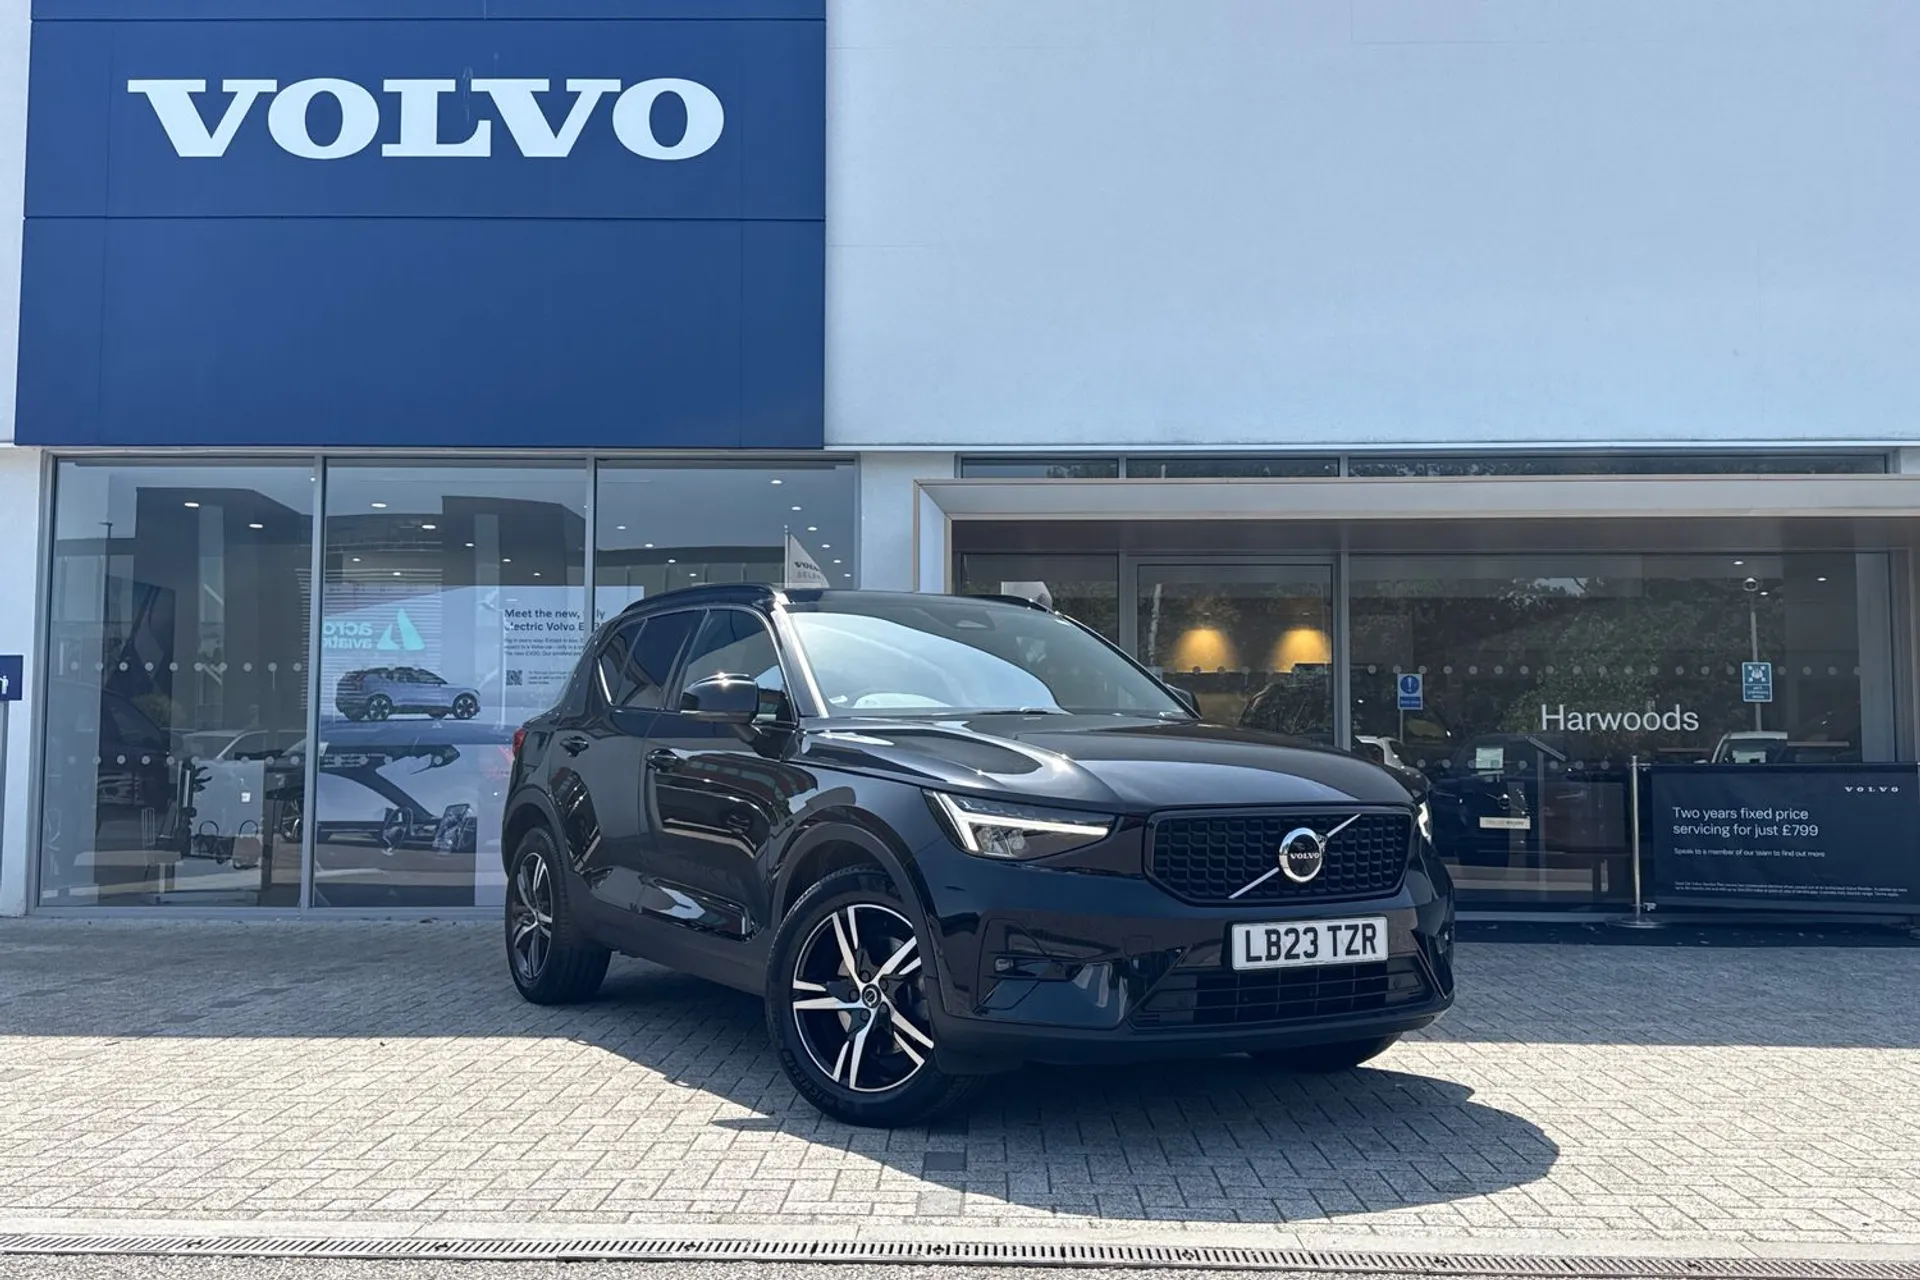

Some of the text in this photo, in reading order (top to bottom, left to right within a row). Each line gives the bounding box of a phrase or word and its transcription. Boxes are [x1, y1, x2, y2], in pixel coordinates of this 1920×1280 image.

[127, 78, 725, 160] VOLVO
[504, 609, 532, 618] Meet
[535, 608, 552, 618] the
[555, 610, 580, 619] new,
[546, 622, 575, 631] Volvo
[1541, 704, 1699, 731] Harwoods
[1672, 806, 1809, 822] Two years fixed price
[1673, 823, 1819, 838] servicing for just £799
[1290, 852, 1320, 860] VOLVO
[1245, 922, 1377, 962] LB23 TZR
